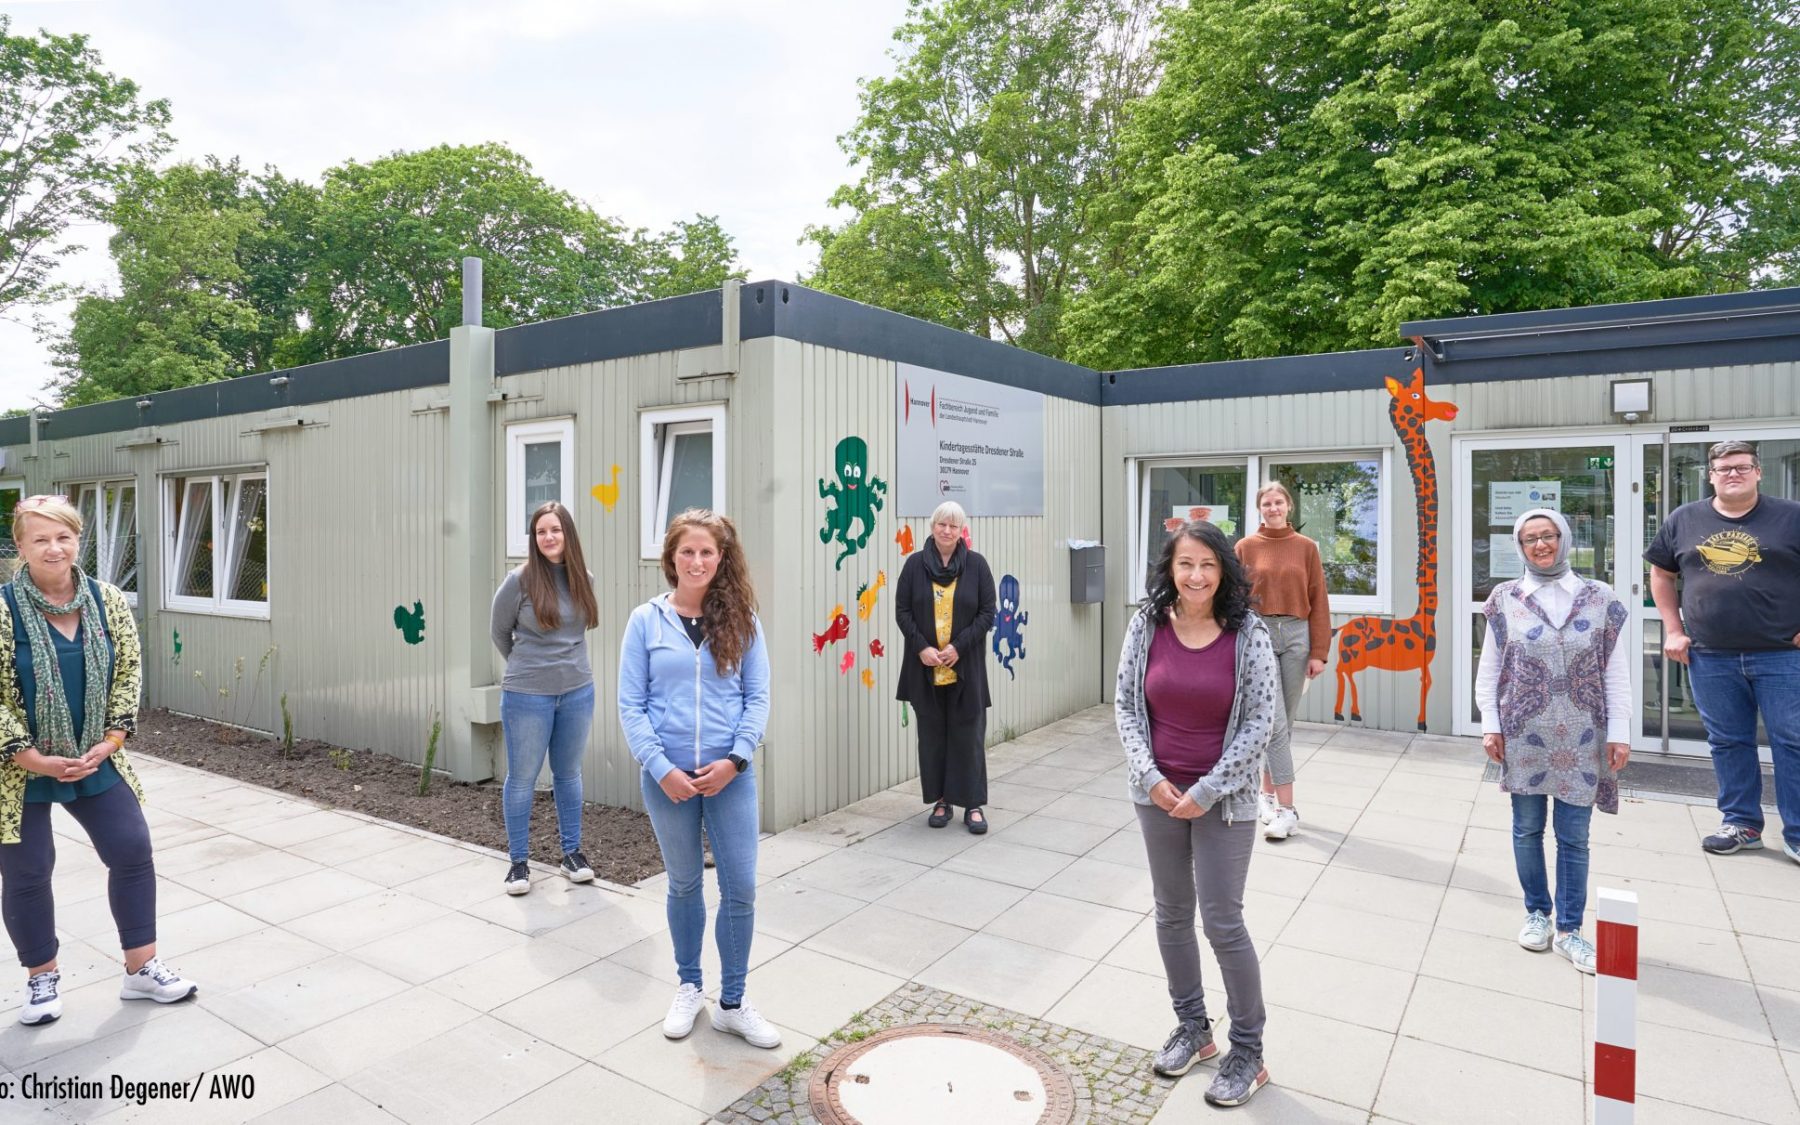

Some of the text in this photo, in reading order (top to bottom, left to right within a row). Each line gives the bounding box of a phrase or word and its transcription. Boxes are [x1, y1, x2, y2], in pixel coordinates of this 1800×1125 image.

[963, 405, 978, 416] Jugend
[940, 440, 1024, 458] Kindertagesstätte Dresdener Straße
